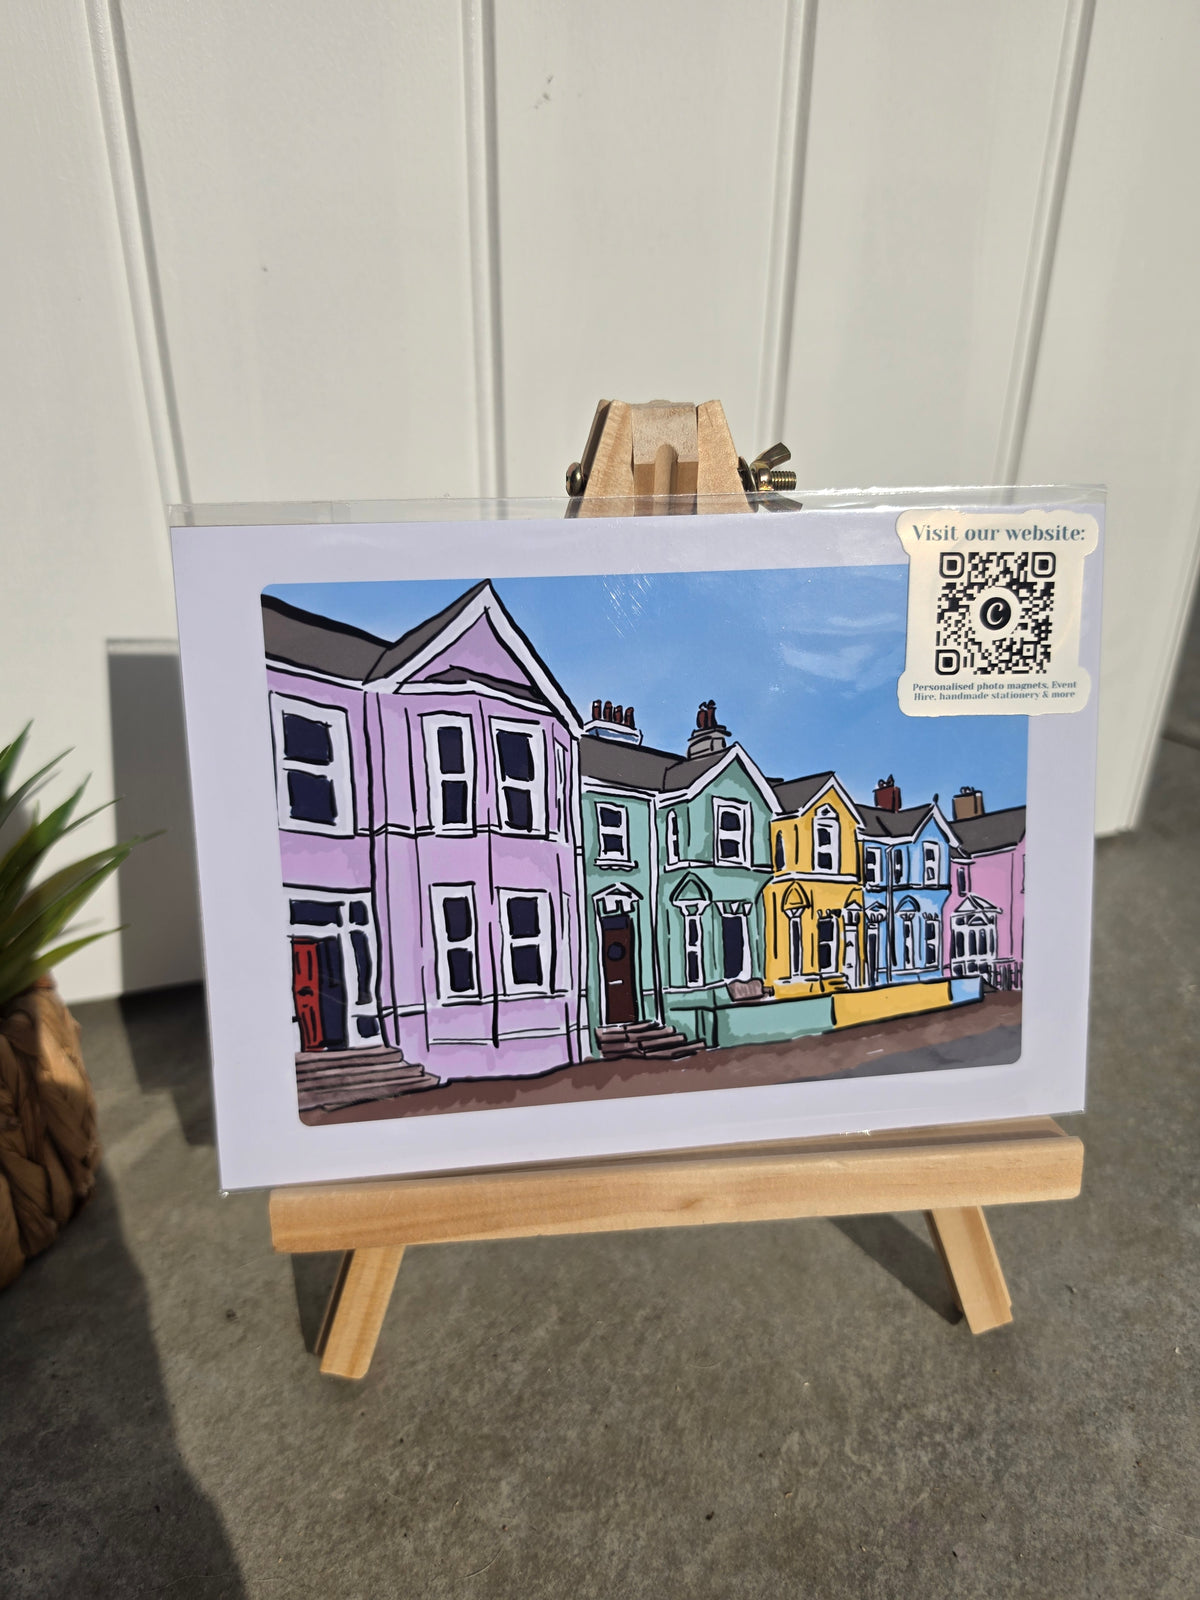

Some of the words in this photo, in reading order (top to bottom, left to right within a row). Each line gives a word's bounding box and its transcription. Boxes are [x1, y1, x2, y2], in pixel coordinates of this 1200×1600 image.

[912, 524, 959, 541] Visit
[964, 527, 1000, 541] our
[1006, 524, 1085, 541] website:
[912, 682, 974, 692] Personalised
[977, 682, 1004, 692] photo
[1007, 682, 1049, 691] magnets,
[1051, 681, 1077, 689] Event
[913, 692, 937, 701] Hire,
[939, 692, 989, 700] handmade
[991, 691, 1039, 700] stationery
[1042, 691, 1049, 699] &
[1051, 691, 1076, 699] more
